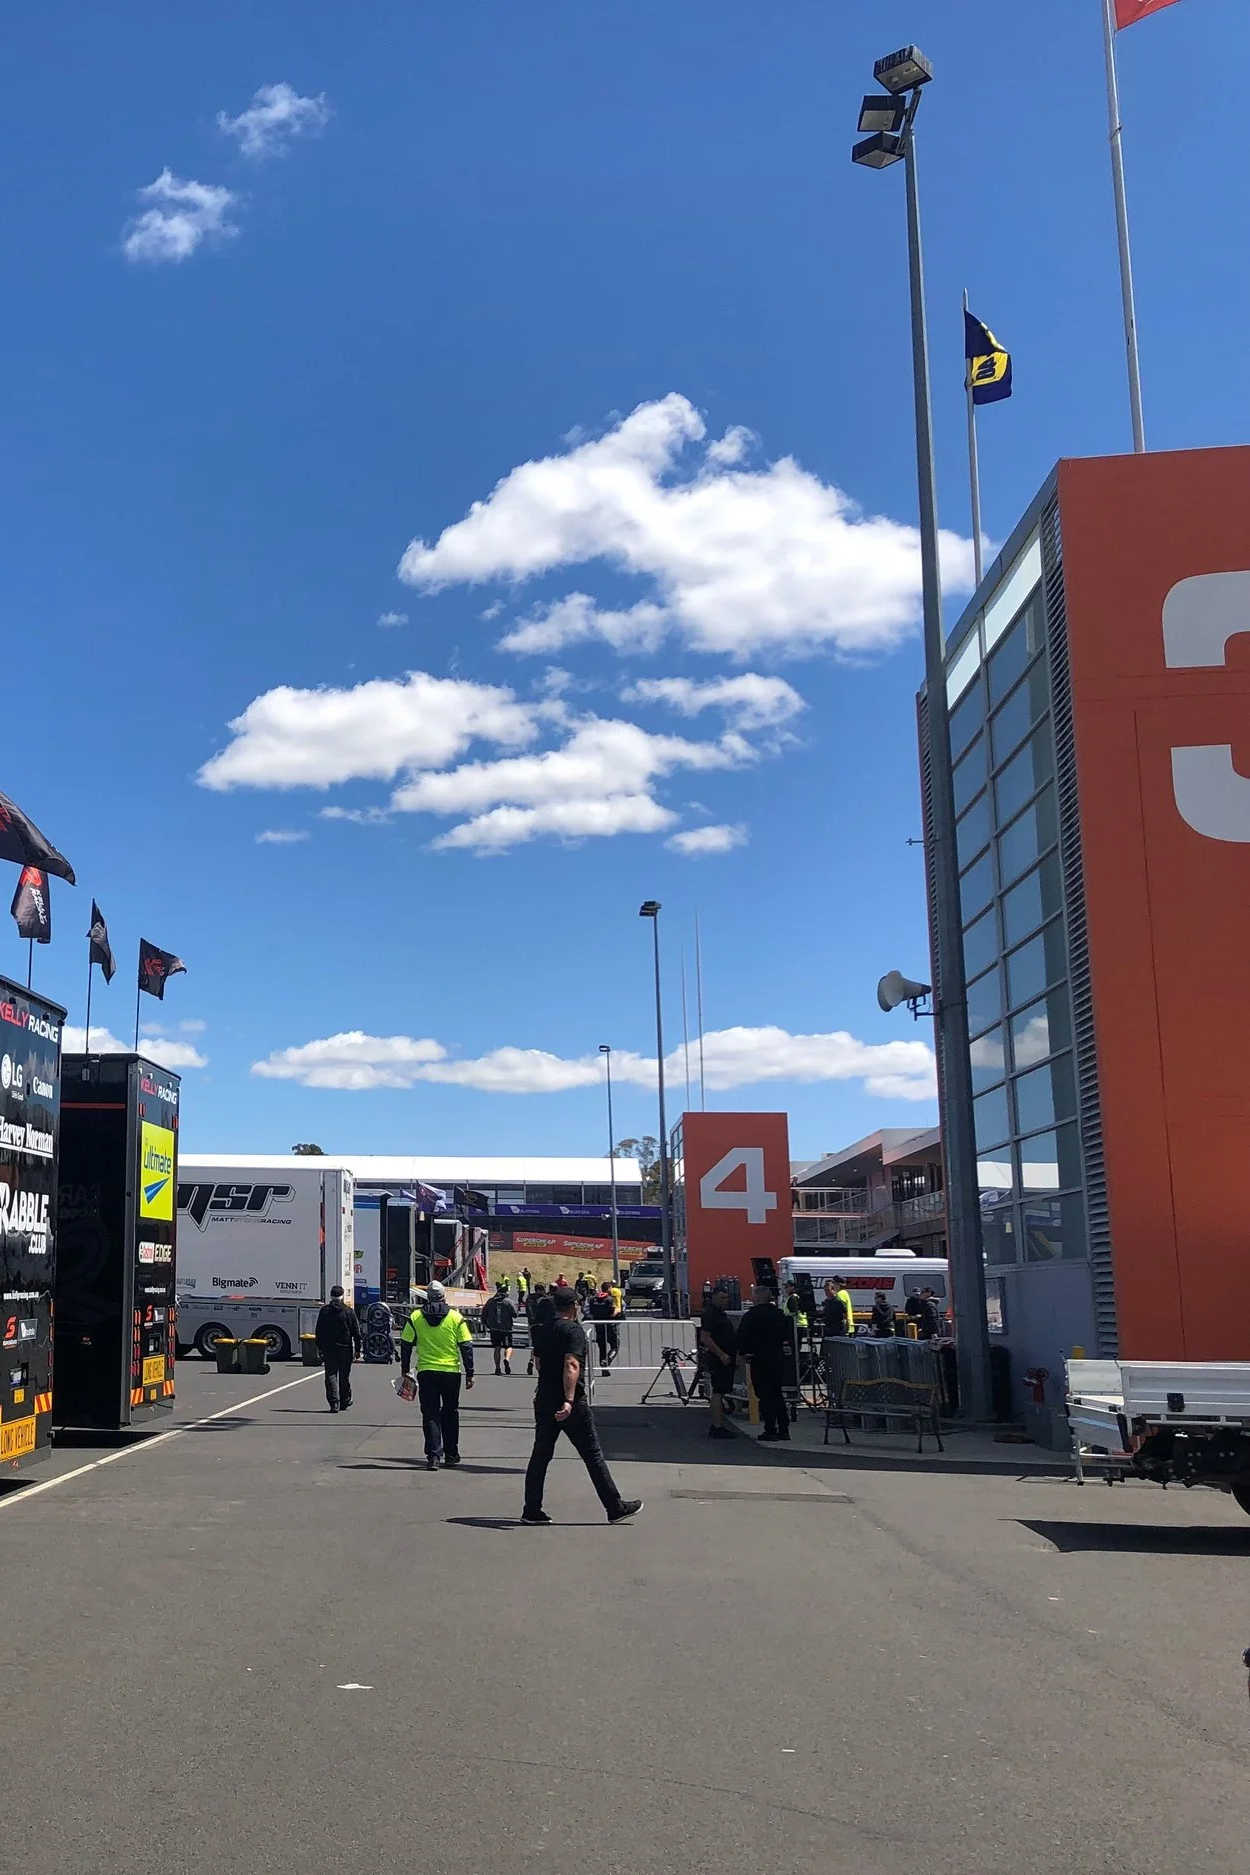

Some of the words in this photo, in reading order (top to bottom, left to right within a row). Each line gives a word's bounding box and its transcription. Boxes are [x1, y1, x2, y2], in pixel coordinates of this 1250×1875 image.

[28, 1014, 59, 1043] RACING
[11, 1061, 23, 1088] LG
[33, 1076, 53, 1099] Canon
[140, 1078, 158, 1097] KELLY
[157, 1085, 177, 1105] RACING
[25, 1122, 53, 1154] Norman
[144, 1145, 172, 1174] ultimate
[700, 1147, 777, 1223] 4
[28, 1233, 47, 1254] .CLUB
[154, 1243, 172, 1262] EDGE
[516, 1237, 556, 1245] SUPERCHEAP
[563, 1240, 604, 1249] SUPERCHEAP
[212, 1277, 249, 1289] Bigmate
[275, 1282, 298, 1290] VENN
[0, 1427, 14, 1455] LONG
[16, 1421, 35, 1449] VEHICLE
